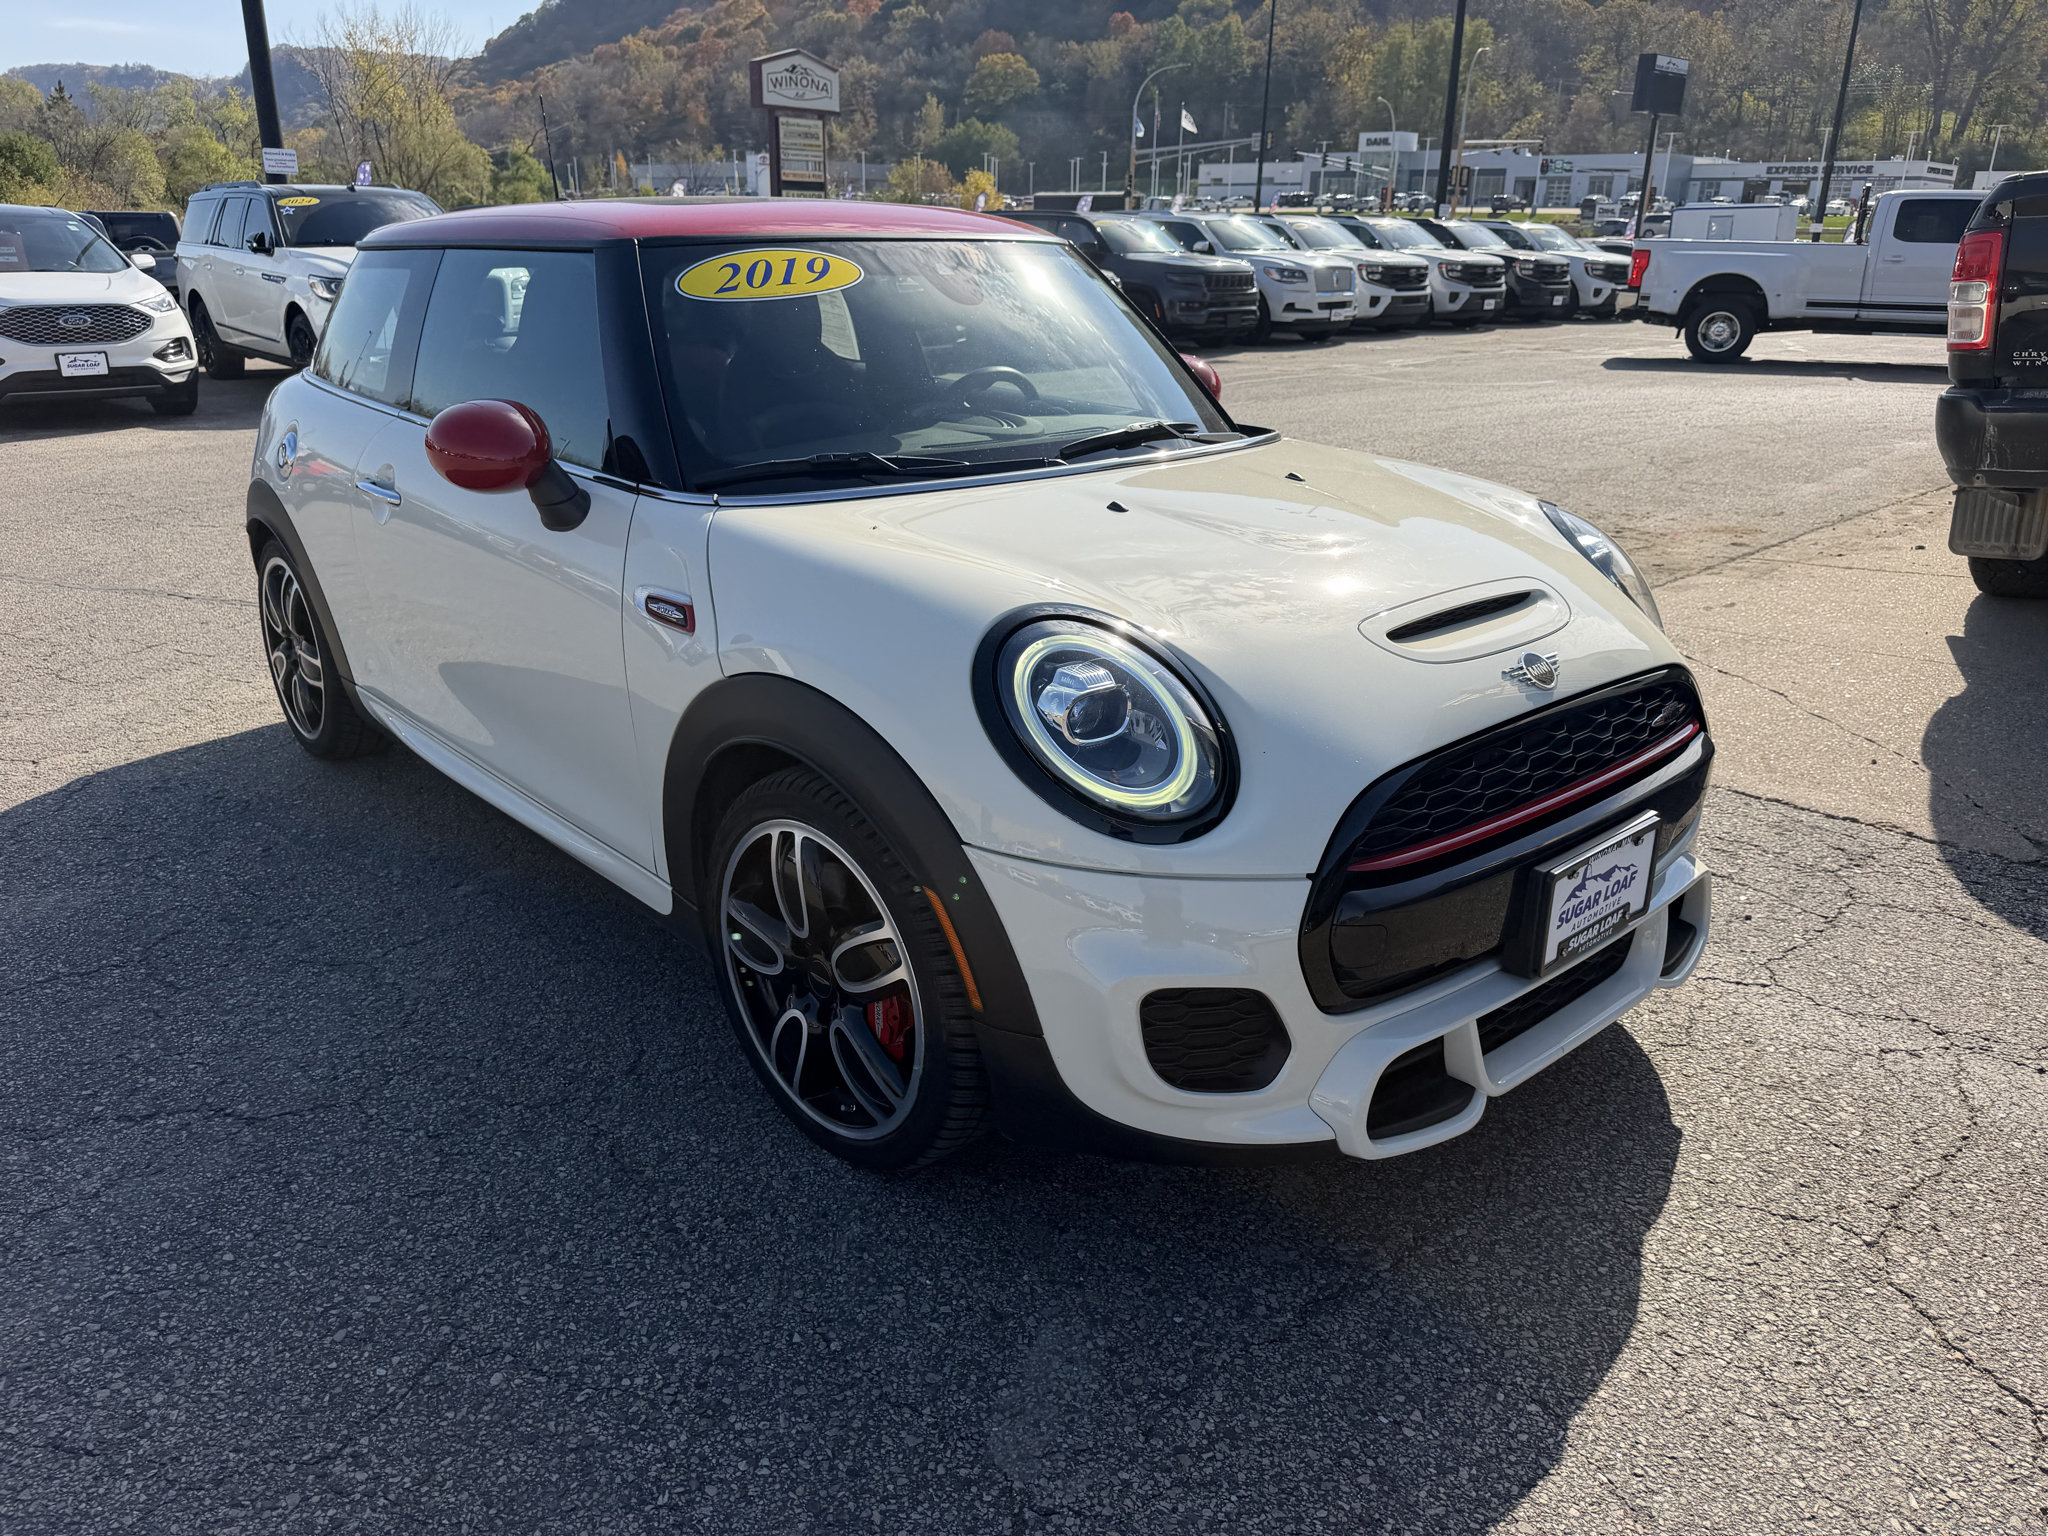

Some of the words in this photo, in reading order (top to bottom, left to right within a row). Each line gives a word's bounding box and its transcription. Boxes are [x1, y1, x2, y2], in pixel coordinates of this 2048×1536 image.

[770, 75, 829, 95] WINONA
[1366, 138, 1391, 146] DAHL
[1766, 166, 1818, 175] EXPRESS
[714, 257, 830, 294] 2019
[1528, 662, 1551, 676] MINI
[1556, 890, 1602, 929] SUGAR
[1604, 870, 1638, 901] LOAF
[1571, 897, 1621, 932] AUTOMOTIVE
[1567, 921, 1600, 951] SUGAR
[1599, 909, 1624, 936] LOAF
[1578, 928, 1613, 953] AUTOMOTIVE
